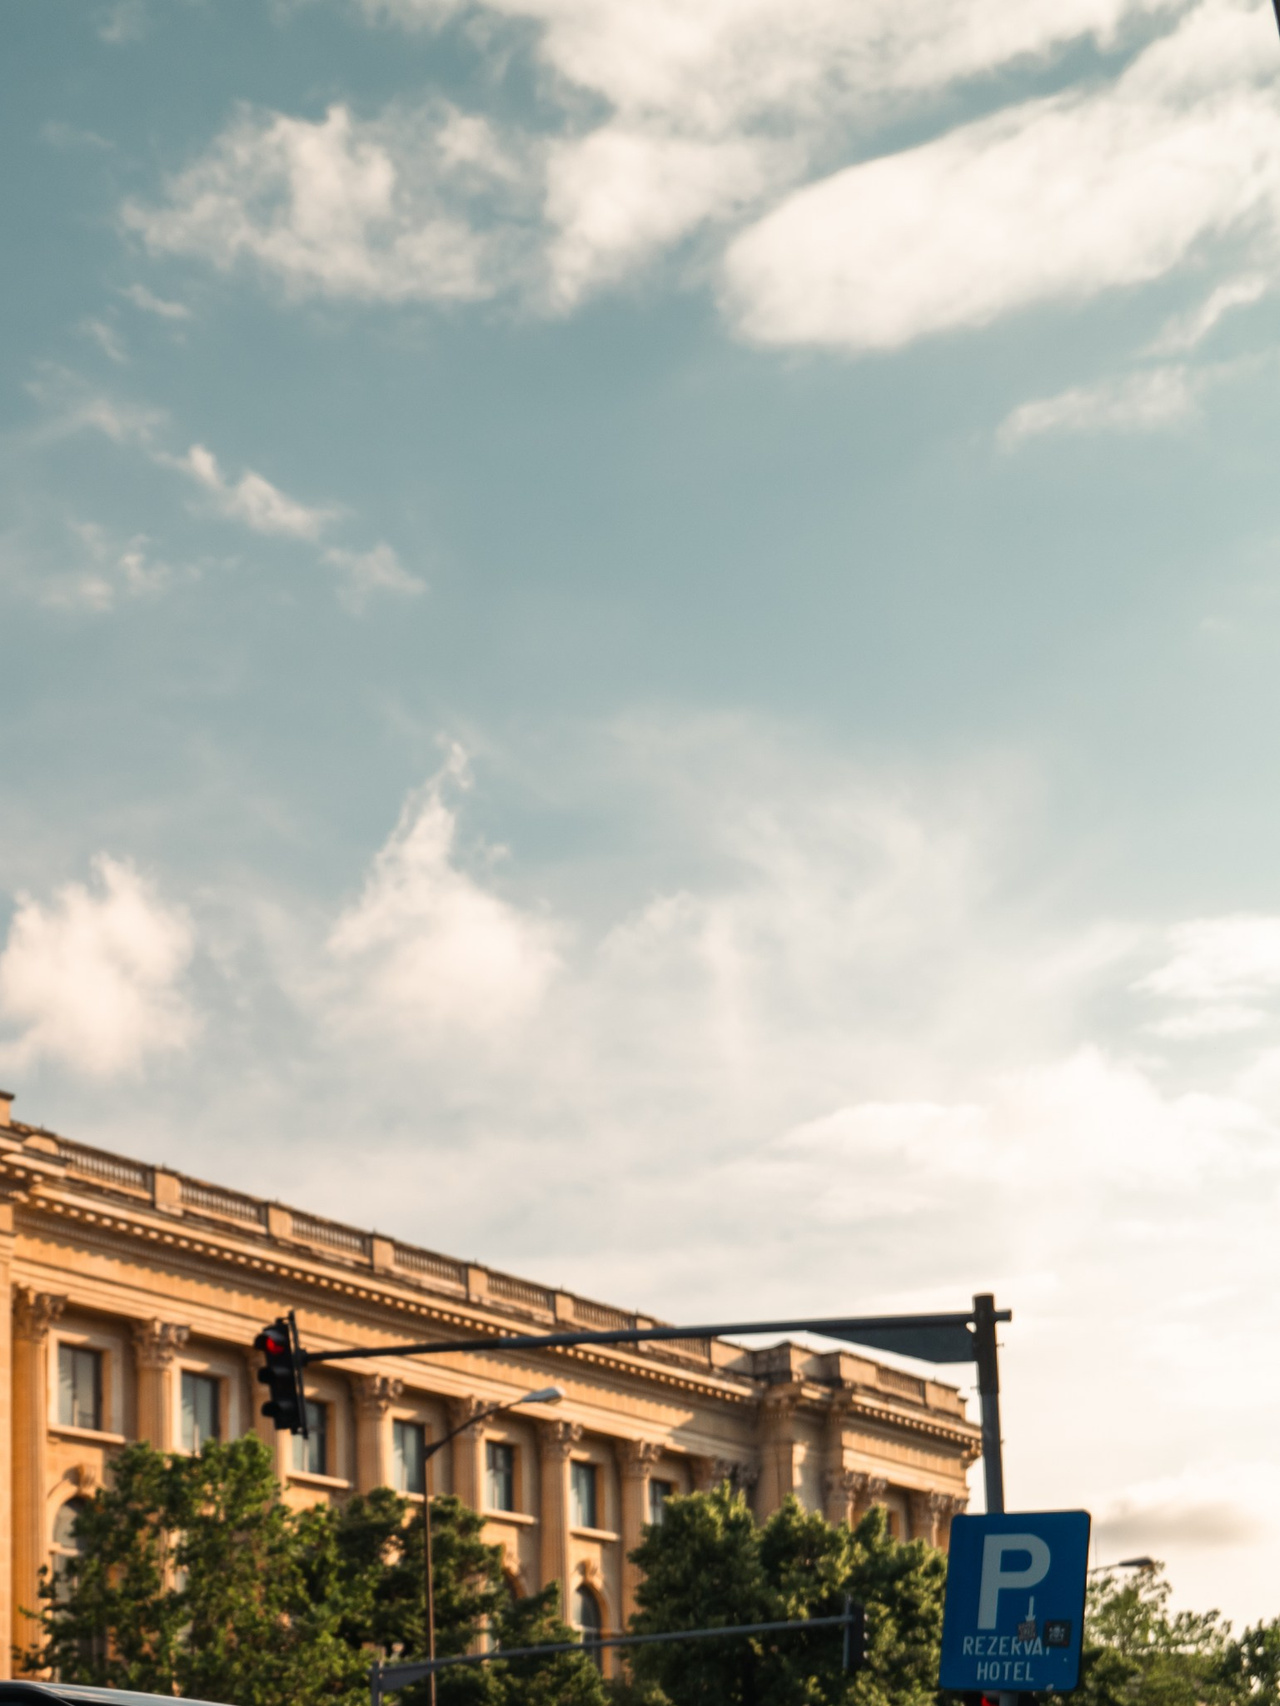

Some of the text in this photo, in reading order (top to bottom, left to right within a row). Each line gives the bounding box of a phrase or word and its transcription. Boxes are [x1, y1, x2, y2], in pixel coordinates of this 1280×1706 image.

[977, 1533, 1051, 1630] P
[962, 1636, 1051, 1656] REZERVA
[976, 1661, 1034, 1682] HOTEL
